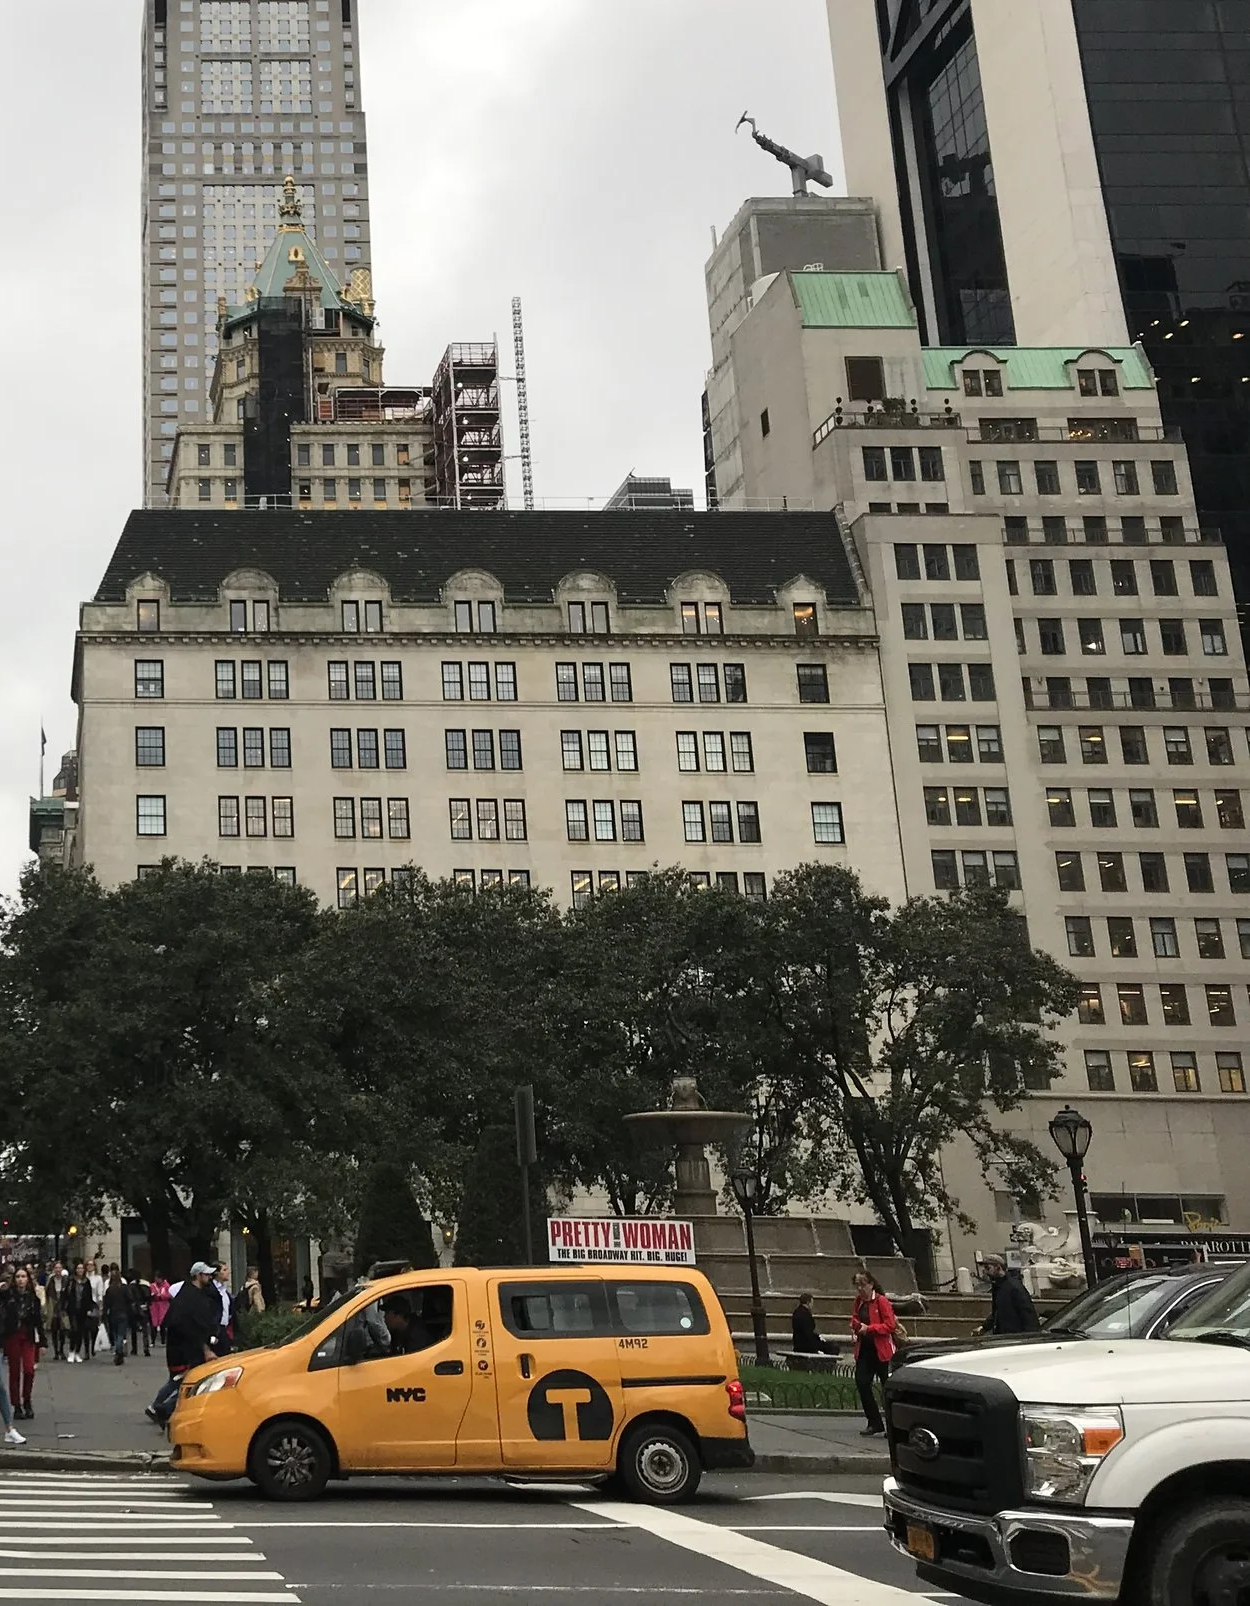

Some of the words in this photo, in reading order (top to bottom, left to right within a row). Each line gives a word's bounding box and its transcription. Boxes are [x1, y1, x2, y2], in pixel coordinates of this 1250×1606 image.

[550, 1220, 611, 1248] PRETTY
[622, 1222, 692, 1250] WOMAN
[557, 1248, 570, 1259] THE
[573, 1249, 586, 1260] BIG
[588, 1249, 628, 1261] BROADWAY
[630, 1251, 645, 1261] HIT.
[647, 1251, 663, 1262] BIG.
[665, 1251, 687, 1262] HUGE!
[619, 1338, 649, 1349] 4M92
[386, 1387, 426, 1402] NYC
[545, 1388, 592, 1441] T
